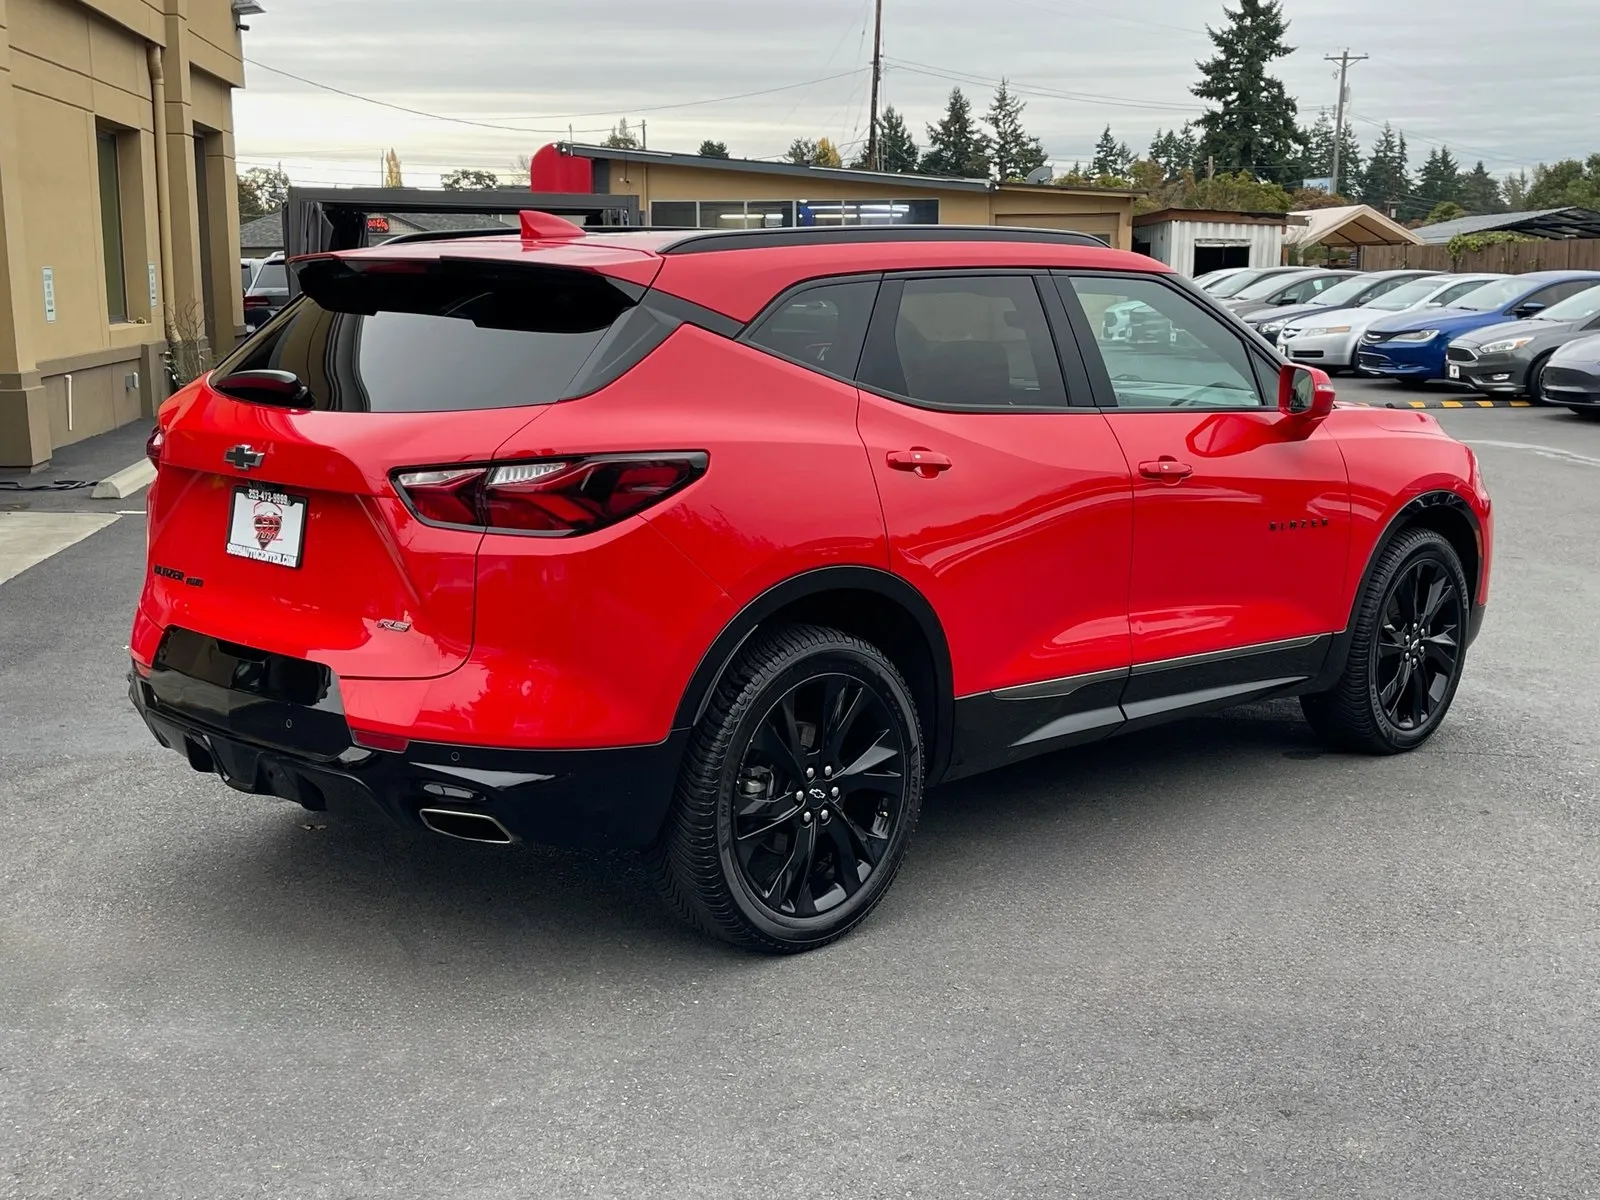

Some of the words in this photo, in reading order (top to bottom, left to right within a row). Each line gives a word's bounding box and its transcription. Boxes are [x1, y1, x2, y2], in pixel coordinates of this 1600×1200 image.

[248, 489, 288, 505] 253-473-9999
[1269, 518, 1328, 531] BLAZER
[376, 619, 411, 632] RS
